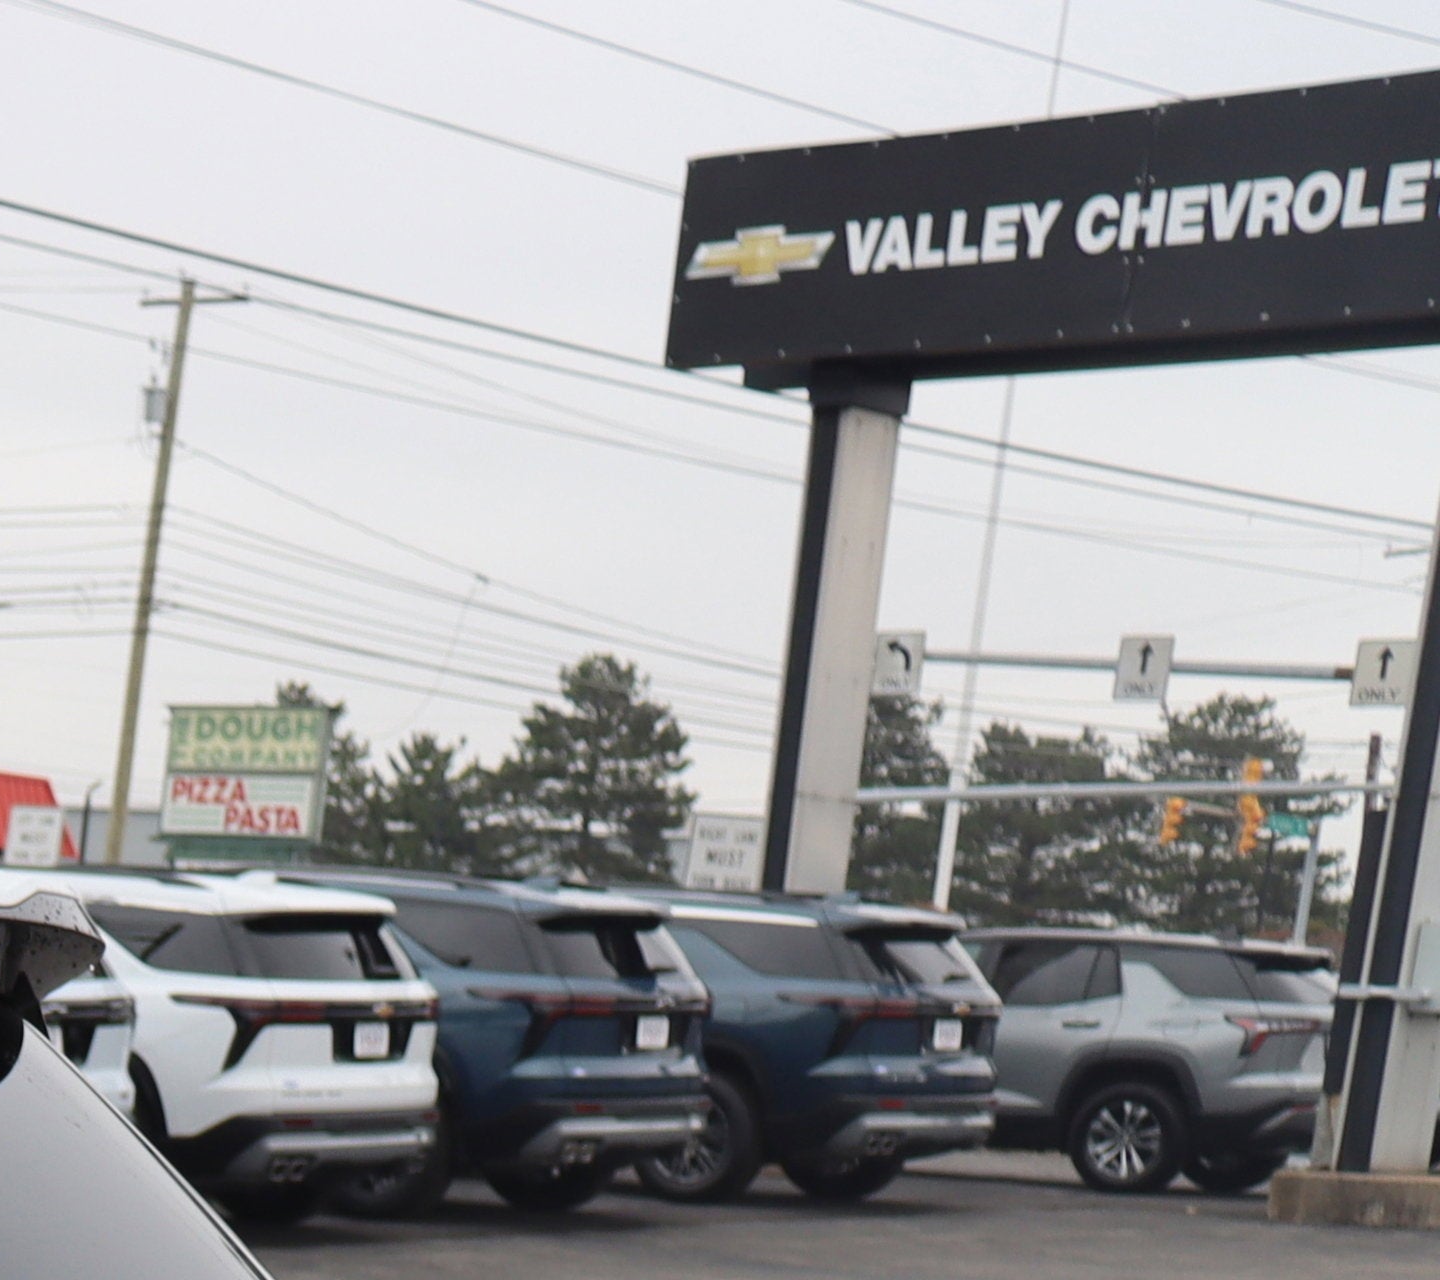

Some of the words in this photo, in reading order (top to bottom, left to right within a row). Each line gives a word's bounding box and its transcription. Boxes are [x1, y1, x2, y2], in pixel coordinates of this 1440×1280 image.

[845, 200, 1063, 276] VALLEY
[1076, 159, 1440, 256] CHEVROLE
[1358, 685, 1402, 701] ONLY
[194, 715, 317, 742] DOUGH
[171, 776, 247, 804] PIZZA
[224, 806, 301, 833] PASTA
